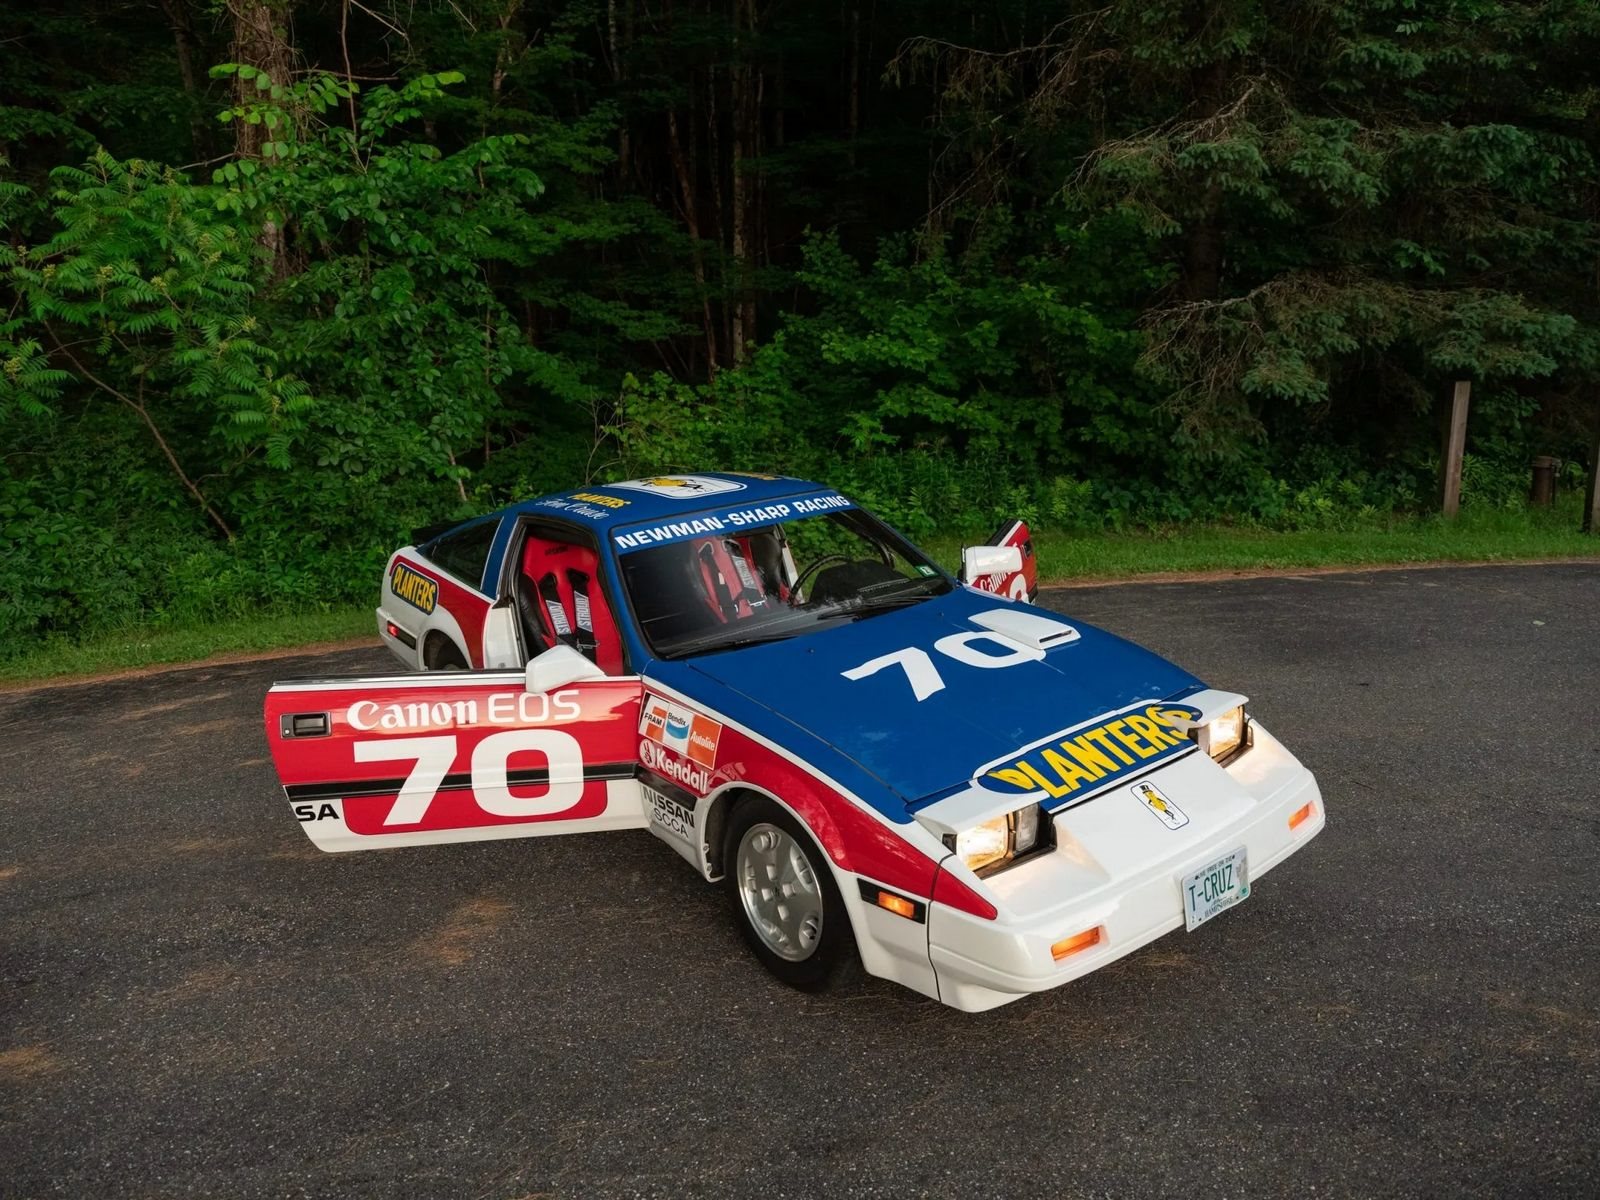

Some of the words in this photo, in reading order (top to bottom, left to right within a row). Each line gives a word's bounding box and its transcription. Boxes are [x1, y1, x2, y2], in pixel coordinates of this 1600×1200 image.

[615, 503, 791, 549] NEWMAN-SHARP
[792, 494, 851, 514] RACING
[392, 565, 436, 612] PLANTERS
[840, 630, 1047, 702] 70
[346, 697, 478, 731] Canon
[487, 690, 582, 723] EOS
[643, 712, 663, 727] FRAM
[667, 711, 687, 727] Bendix
[690, 730, 716, 752] Autolite
[986, 706, 1193, 798] PLANTERS
[352, 728, 585, 827] 70
[654, 748, 709, 795] Kendall
[294, 803, 340, 822] SA
[642, 786, 695, 828] NISSAN
[653, 807, 689, 839] SCCA
[1188, 863, 1235, 912] T-CRUZ
